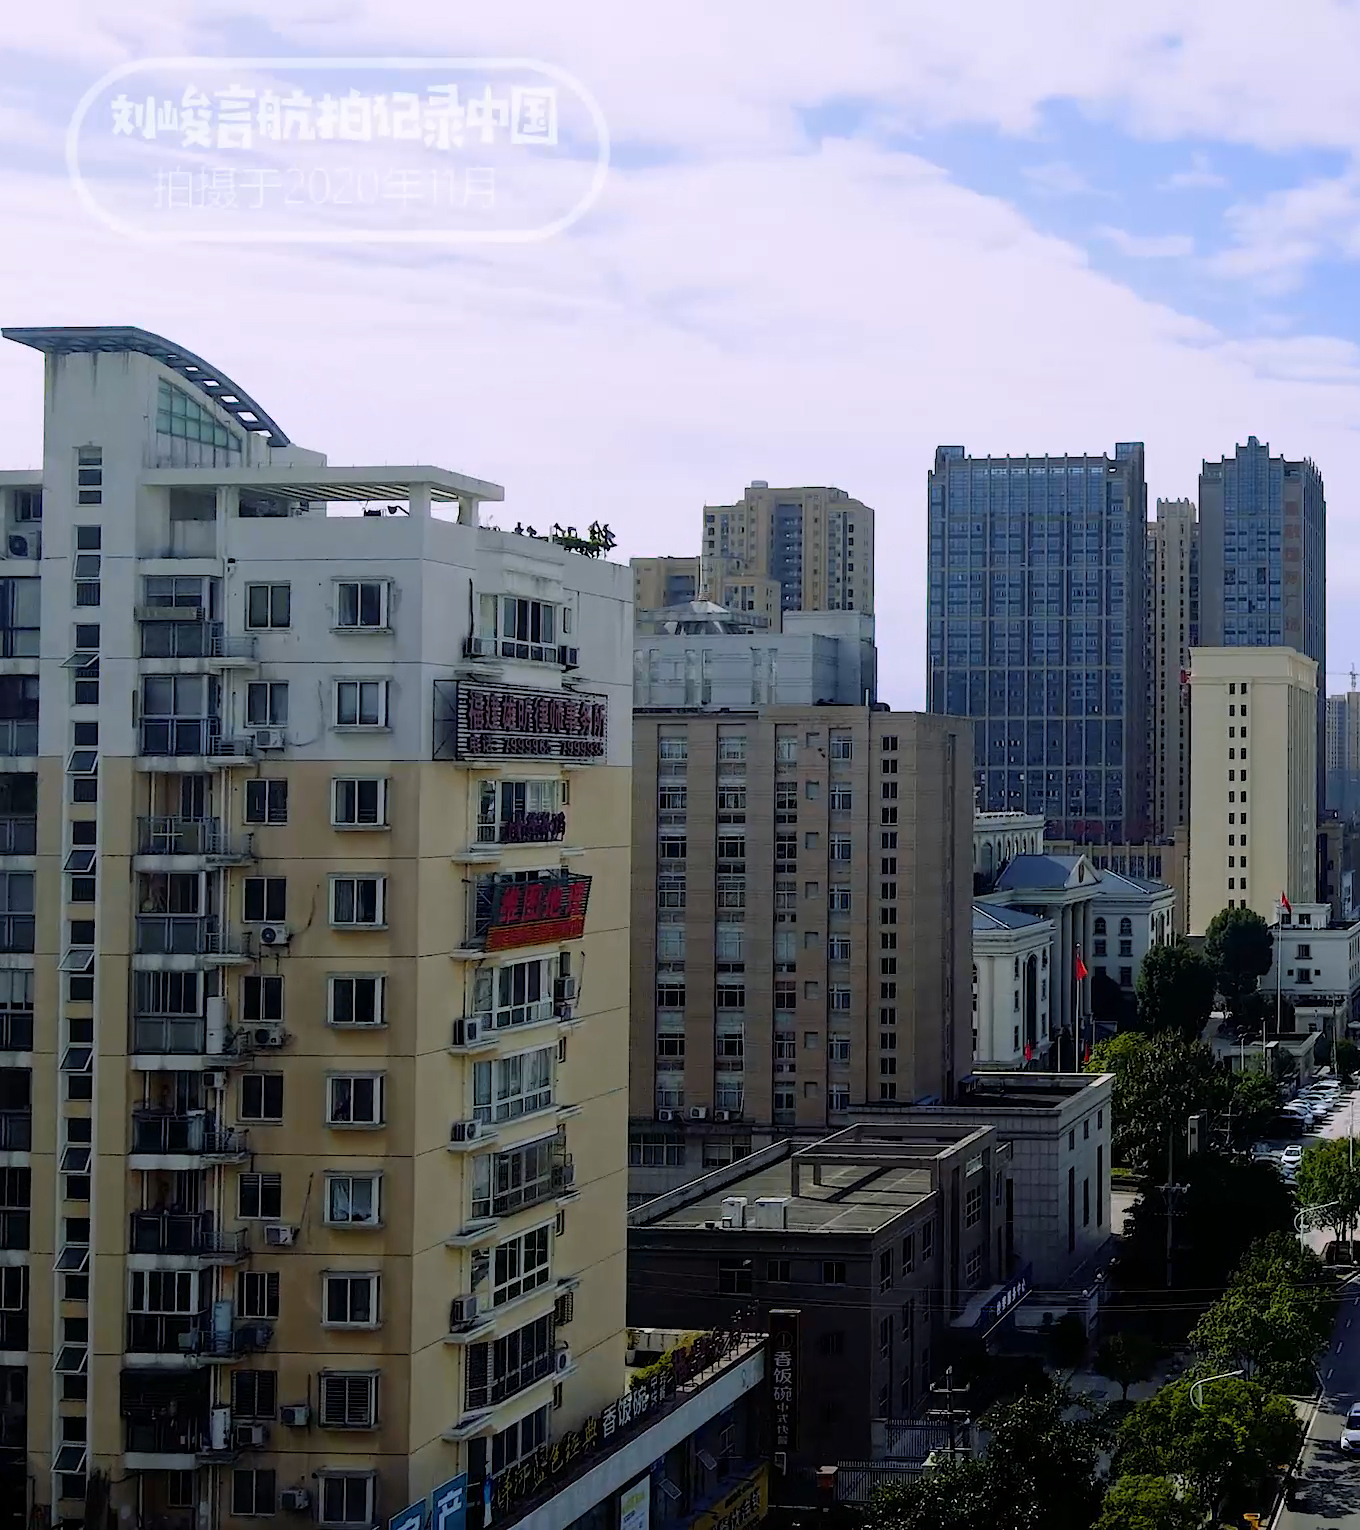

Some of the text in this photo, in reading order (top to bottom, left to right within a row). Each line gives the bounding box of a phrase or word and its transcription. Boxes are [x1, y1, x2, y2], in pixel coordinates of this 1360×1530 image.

[773, 1350, 792, 1402] 香饭碗
[603, 1385, 649, 1438] 香饭碗
